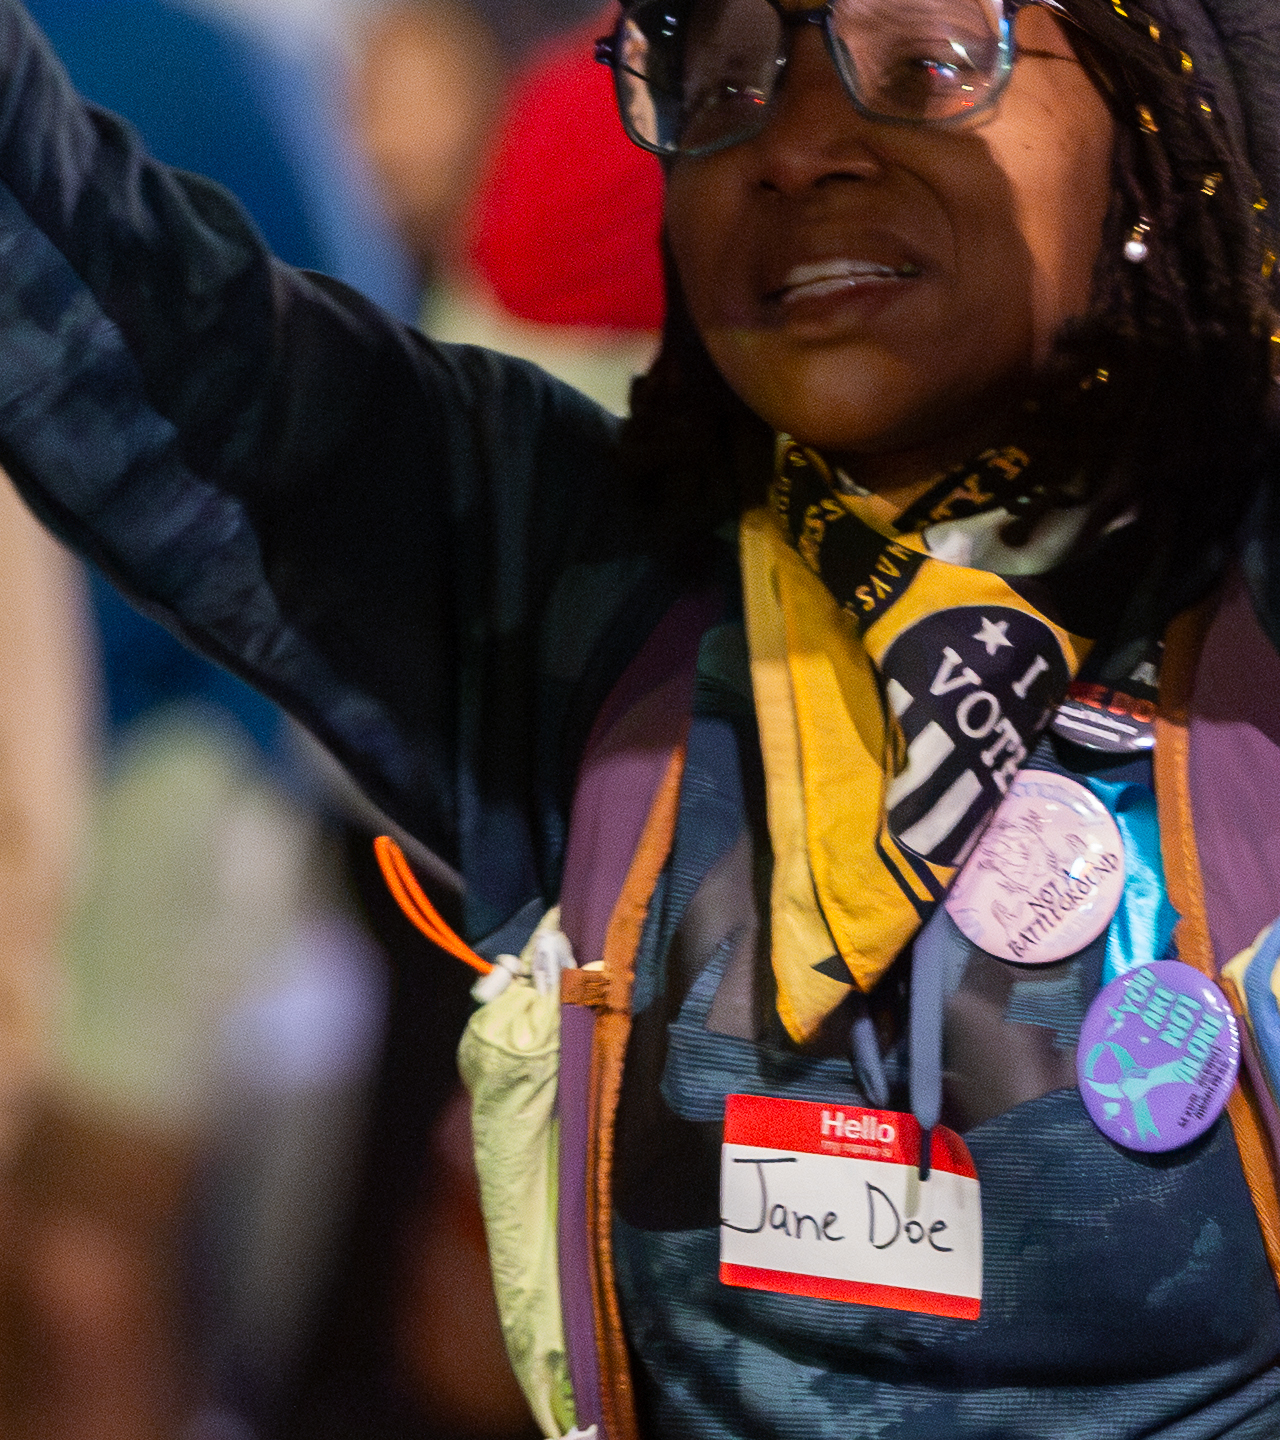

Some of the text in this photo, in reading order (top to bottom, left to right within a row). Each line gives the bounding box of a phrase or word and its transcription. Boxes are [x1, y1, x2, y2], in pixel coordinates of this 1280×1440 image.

[1011, 654, 1050, 699] I
[1117, 966, 1160, 1018] YOU
[1138, 985, 1178, 1030] ARE
[1156, 992, 1204, 1048] NOT
[821, 1110, 896, 1143] Hello
[721, 1157, 954, 1252] Jane Doe
